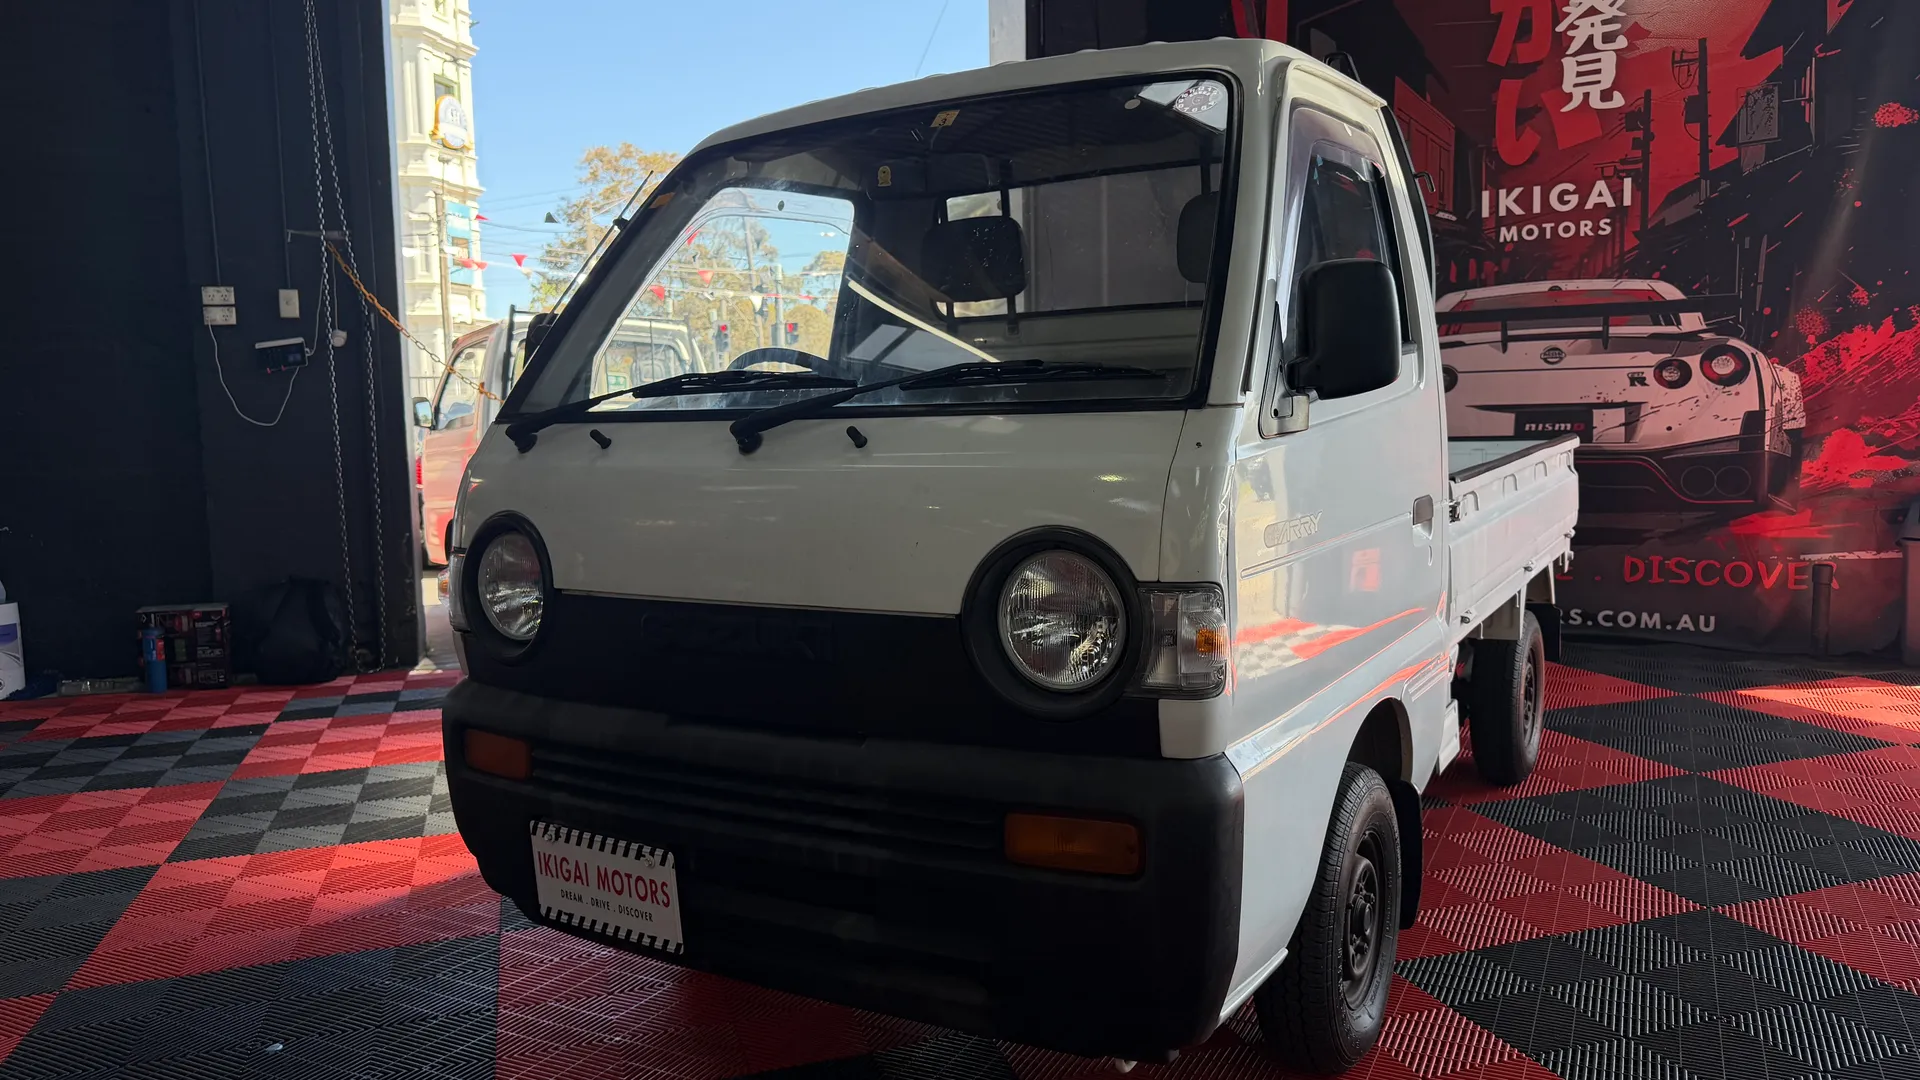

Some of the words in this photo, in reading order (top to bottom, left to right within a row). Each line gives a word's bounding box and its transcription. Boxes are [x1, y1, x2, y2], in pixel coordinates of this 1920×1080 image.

[1555, 0, 1628, 112] 発見
[1481, 177, 1632, 218] IKIGAI
[1499, 218, 1612, 243] MOTORS
[537, 851, 590, 887] IKIGAI
[597, 865, 671, 908] MOTORS
[560, 889, 584, 904] DREAM
[590, 897, 611, 911] DRIVE
[618, 904, 654, 922] DISCOVER
